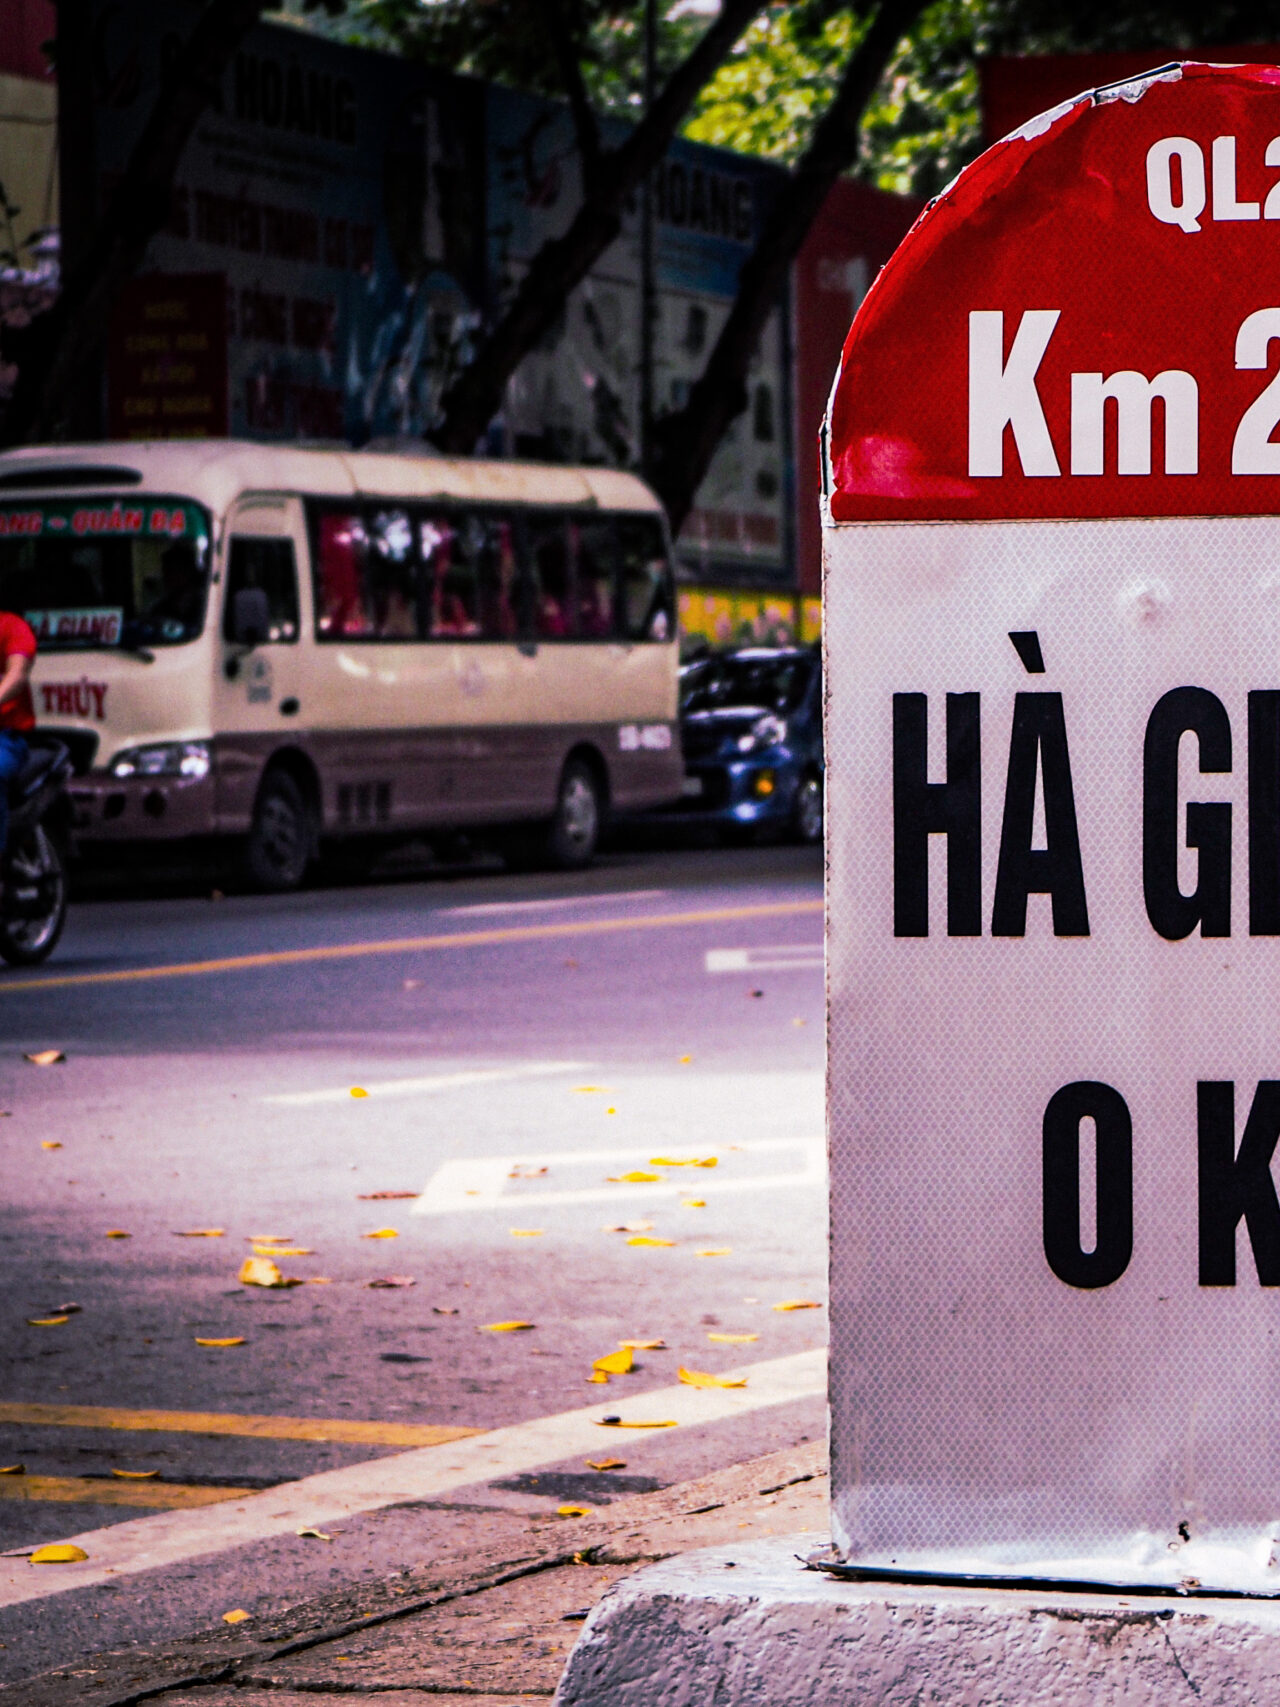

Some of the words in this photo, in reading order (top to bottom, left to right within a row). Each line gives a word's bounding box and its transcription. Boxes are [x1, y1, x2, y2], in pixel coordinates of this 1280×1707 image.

[967, 309, 1199, 478] Km
[892, 630, 1091, 938] HÀ
[1042, 1080, 1134, 1289] 0
